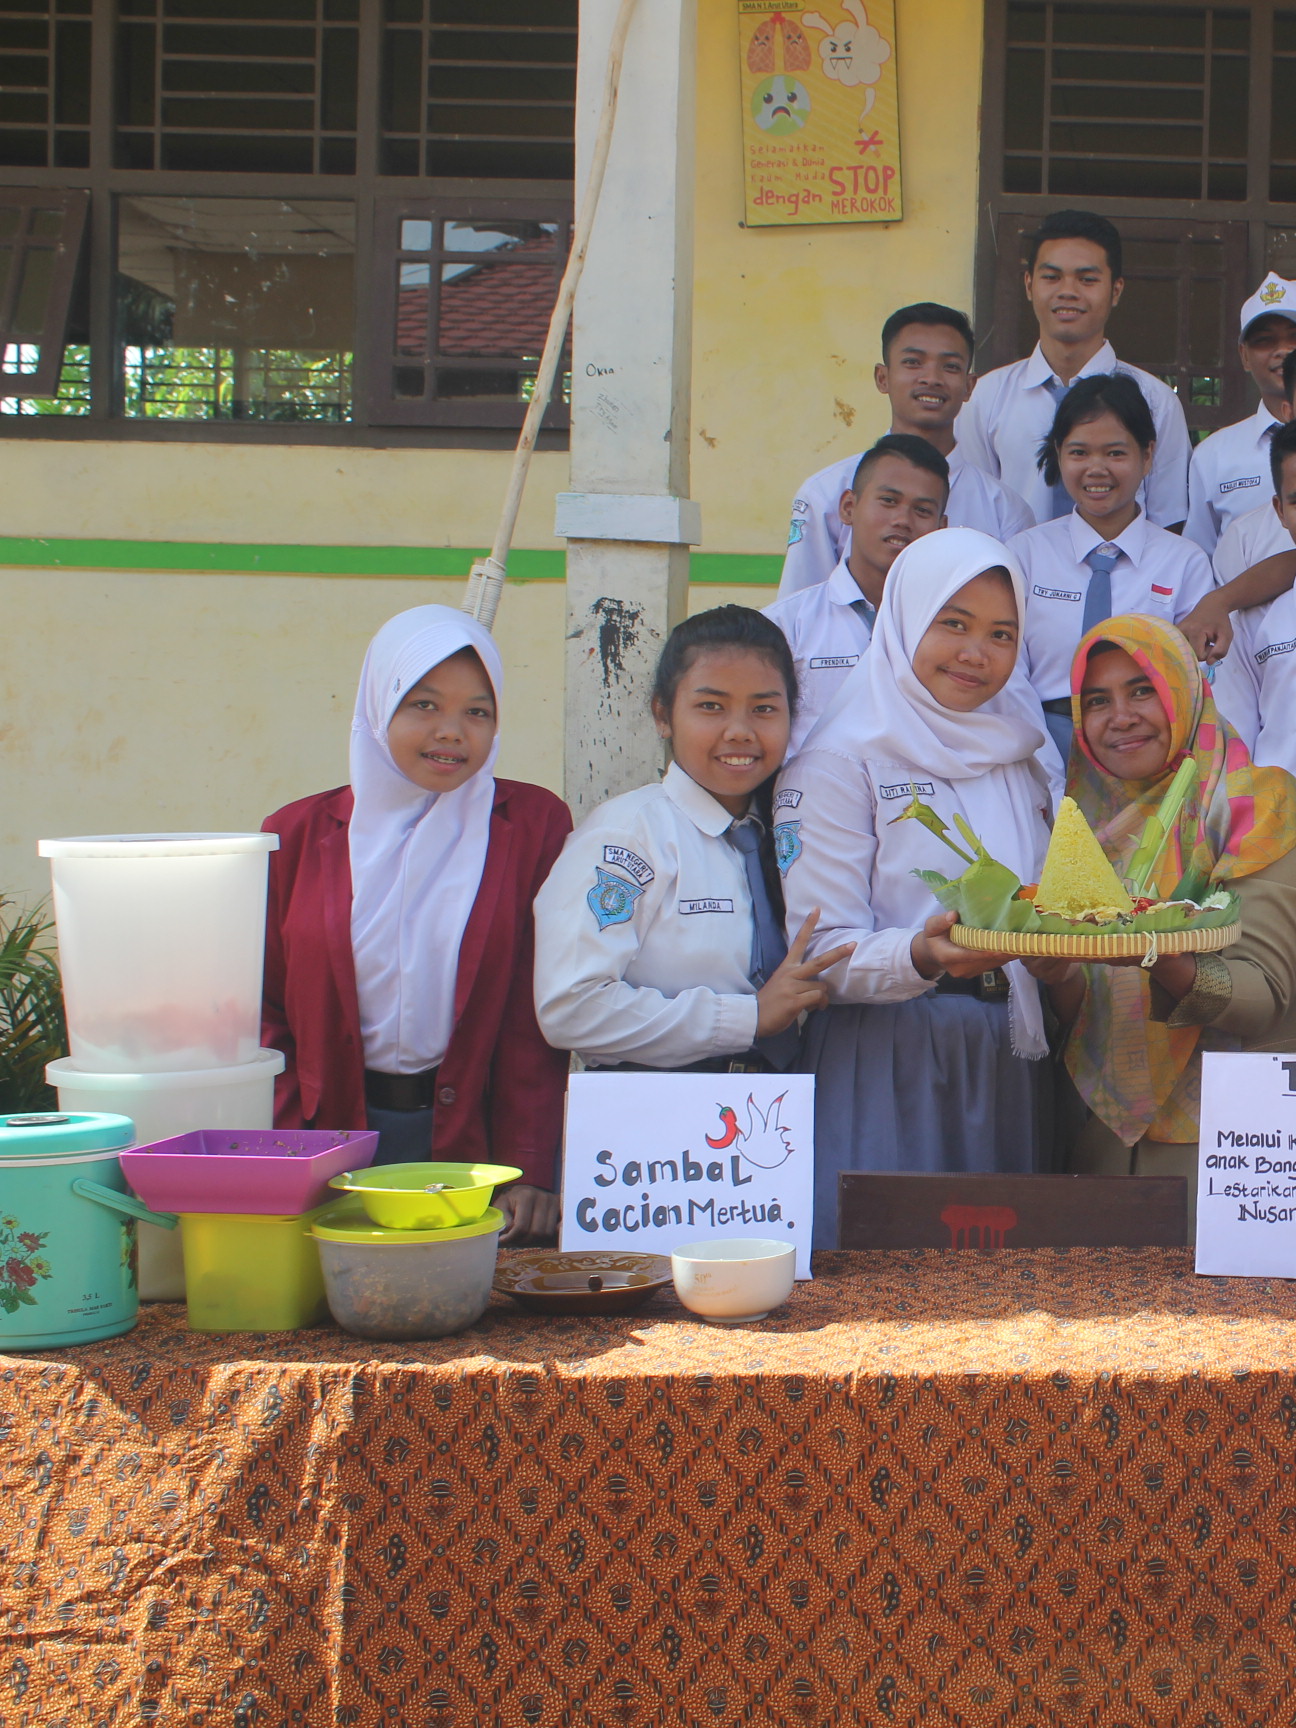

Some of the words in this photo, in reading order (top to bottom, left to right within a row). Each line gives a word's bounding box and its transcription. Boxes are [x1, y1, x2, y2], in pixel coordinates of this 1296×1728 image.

[750, 144, 825, 154] Selamatkan
[750, 159, 789, 169] Generasi
[792, 158, 799, 167] &
[802, 157, 826, 167] Dunia
[751, 174, 783, 183] Kaum
[795, 172, 826, 181] Muda
[829, 165, 896, 196] STOP
[753, 186, 823, 216] dengan
[831, 197, 896, 215] MEROKOK
[608, 848, 624, 857] SMA
[625, 852, 648, 872] NEGERI
[611, 854, 627, 866] ARUT
[1206, 1155, 1250, 1170] anak
